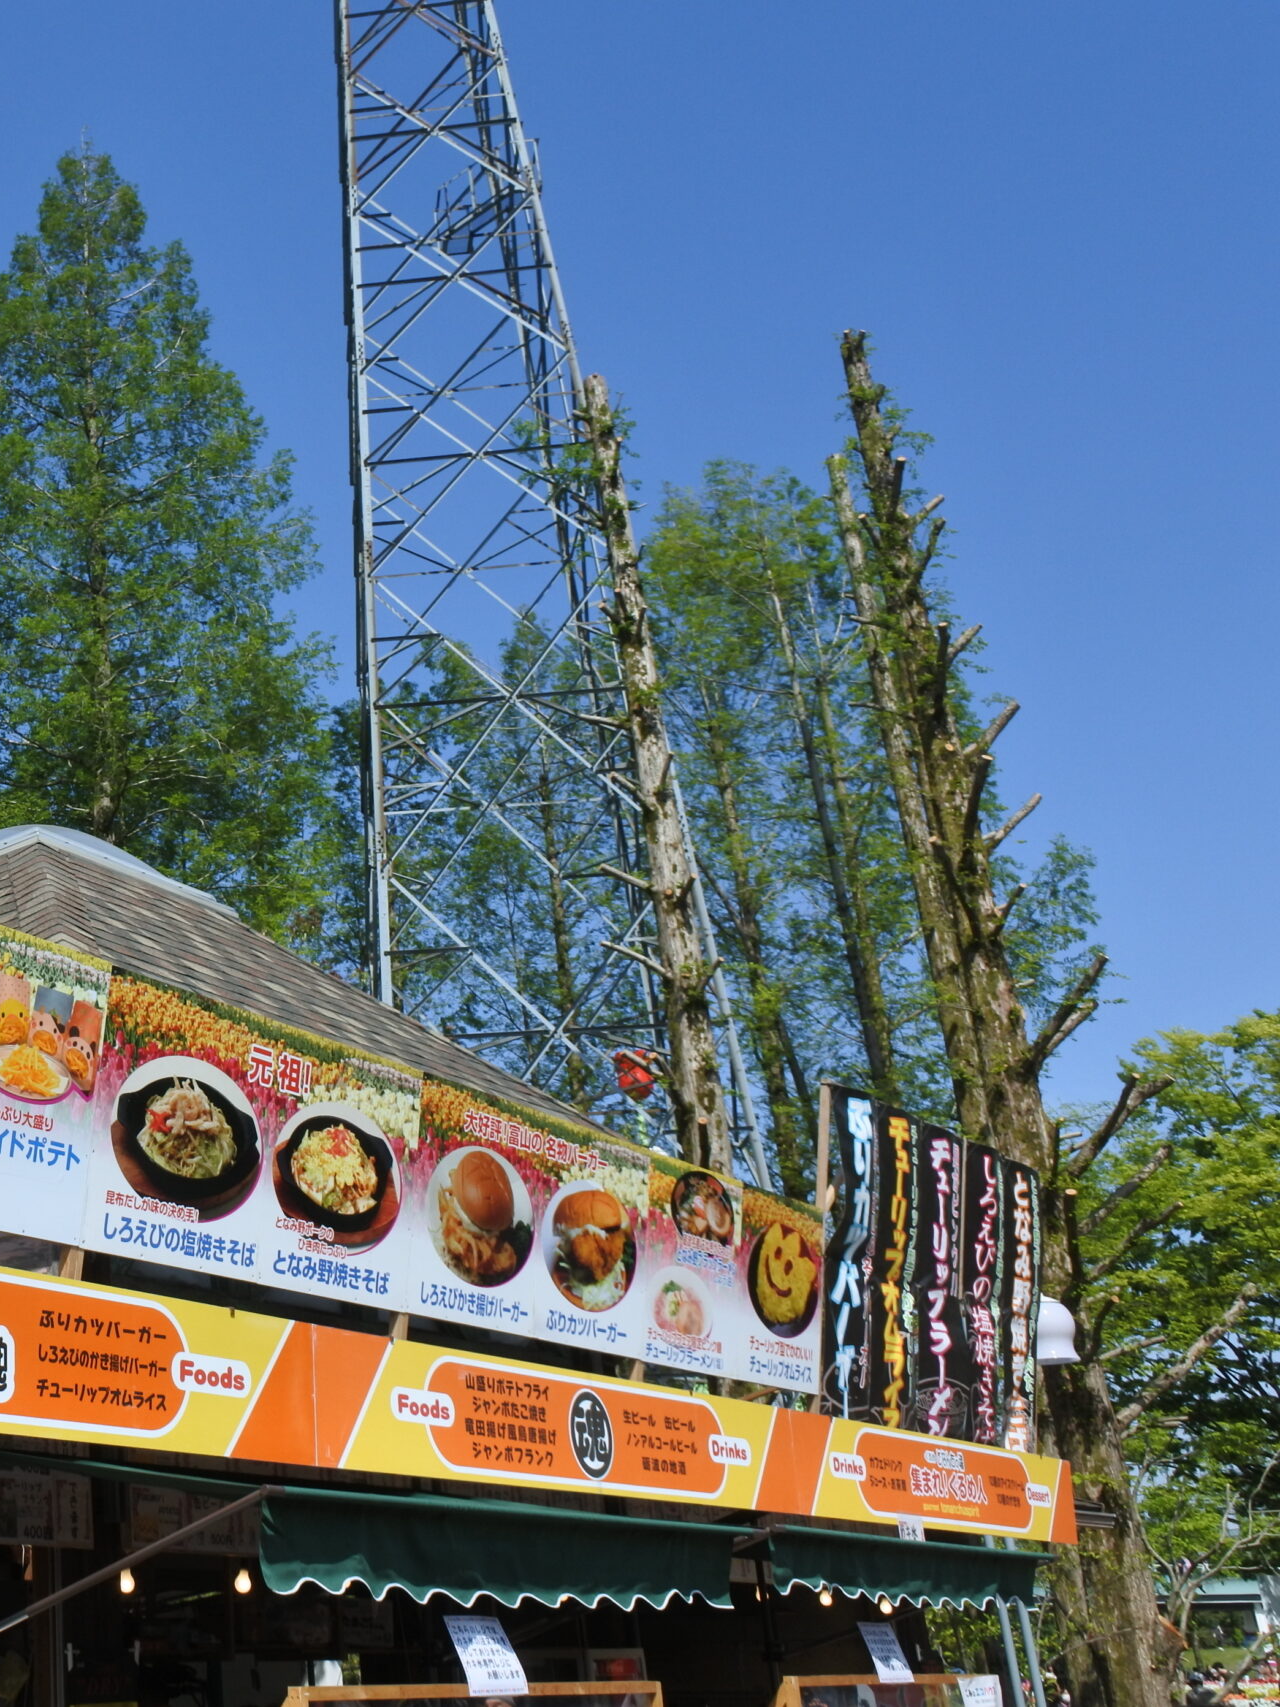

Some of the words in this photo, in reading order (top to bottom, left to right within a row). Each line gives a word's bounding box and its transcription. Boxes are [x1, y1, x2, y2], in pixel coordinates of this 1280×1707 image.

[248, 1043, 313, 1096] 元祖!
[103, 1212, 257, 1268] しろえびの塩焼きそば
[273, 1249, 391, 1295] となみ野焼きそば
[880, 1116, 910, 1428] チューリップオムライス
[926, 1137, 952, 1437] チューリップラーメン
[420, 1281, 529, 1323] しろえびかき揚げバーガー
[972, 1154, 997, 1444] しろえびの塩焼きそば
[38, 1309, 167, 1341] ぶりカツバーガー
[546, 1309, 627, 1343] ぶりカツバーガー
[38, 1343, 168, 1377] しろえびのかき揚げバーガー
[179, 1359, 246, 1391] Foods
[749, 1355, 813, 1384] チューリップオムライス
[36, 1378, 167, 1412] チューリップオムライス
[465, 1373, 550, 1402] 山盛りポテトフライ
[397, 1393, 450, 1421] Foods
[472, 1395, 547, 1423] ジャンボたこ焼き
[623, 1409, 656, 1427] 生ビール
[572, 1400, 610, 1471] 魂
[626, 1433, 698, 1455] ノンアルコールビール
[711, 1439, 748, 1461] Drinks
[472, 1440, 554, 1468] ジャンボフランク
[832, 1456, 864, 1476] Drinks
[911, 1465, 988, 1504] 集まれ!くるめ人
[1027, 1487, 1050, 1504] Dessert
